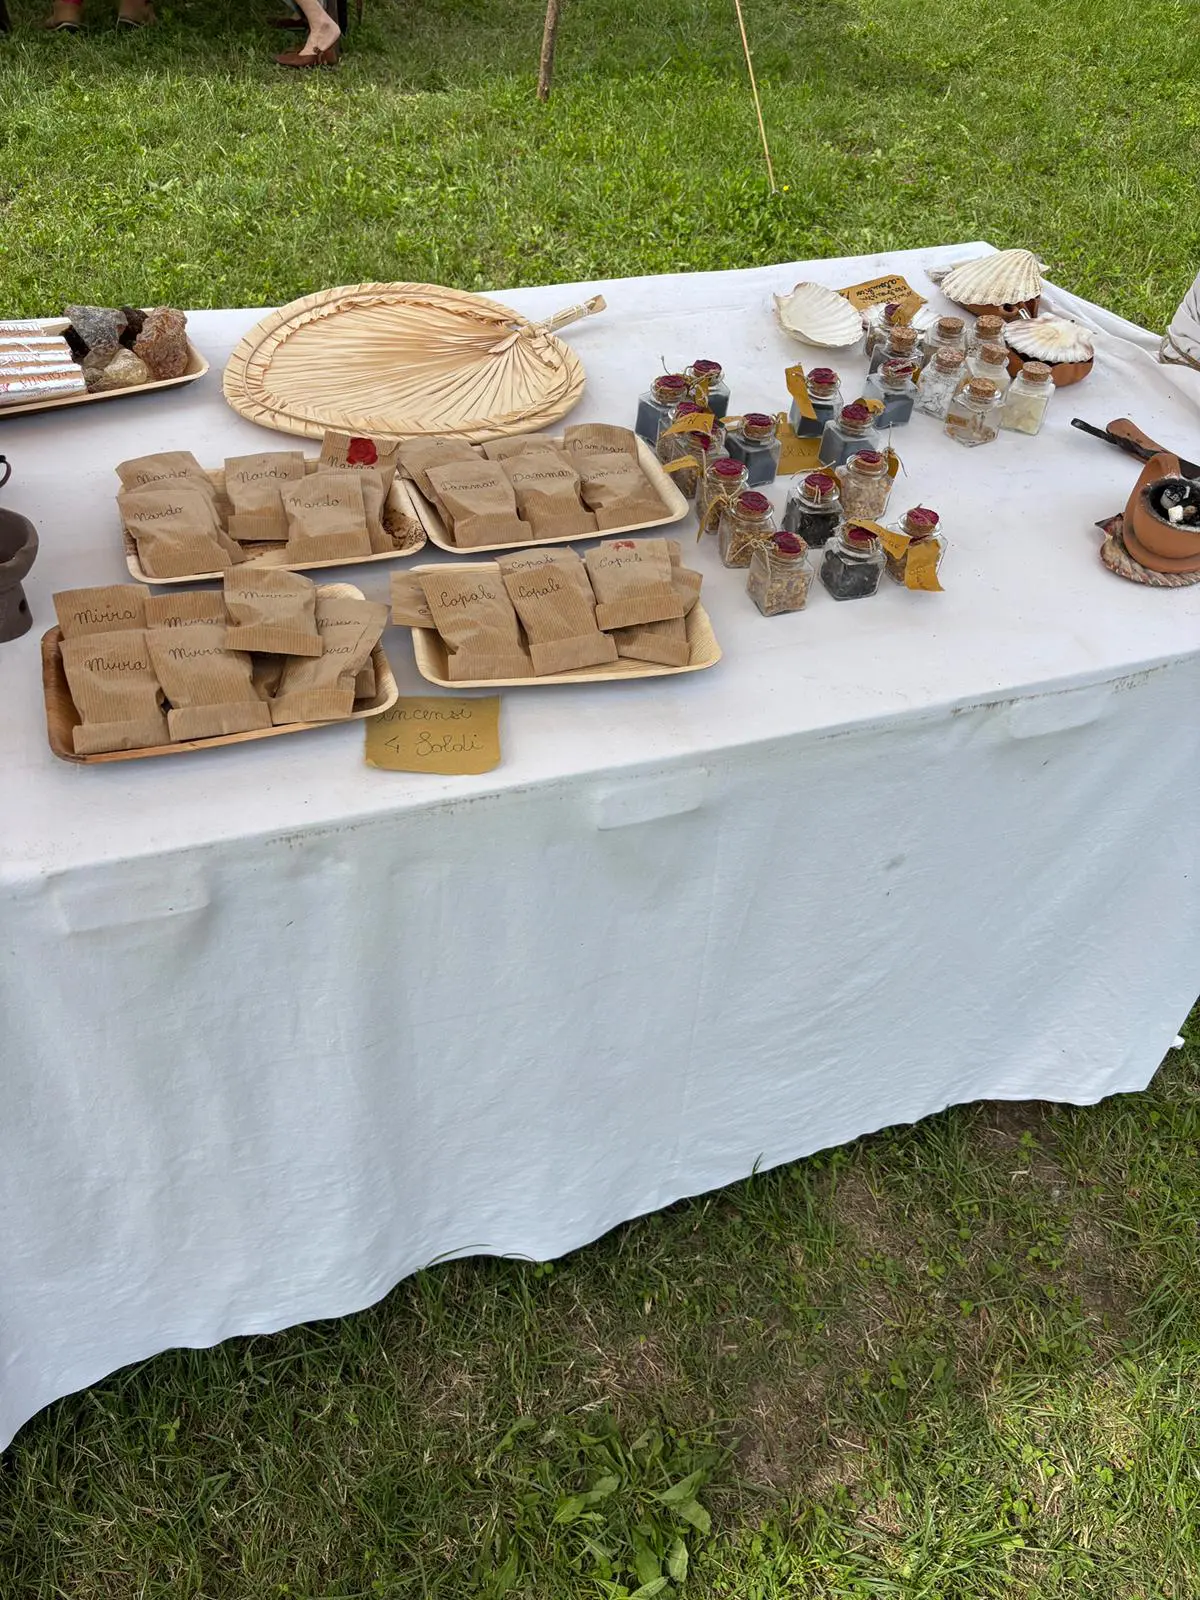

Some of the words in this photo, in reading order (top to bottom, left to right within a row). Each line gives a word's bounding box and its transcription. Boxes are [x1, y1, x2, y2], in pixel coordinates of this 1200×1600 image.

[237, 466, 290, 483] Nardo
[512, 470, 572, 483] Dammar
[290, 494, 342, 509] Nardo
[133, 504, 184, 522] Nardo
[439, 584, 496, 609] Copale
[518, 577, 562, 599] Copale
[74, 604, 138, 625] Mirra
[169, 646, 226, 661] Mirra
[84, 656, 148, 672] Mirra
[384, 735, 400, 754] 4
[415, 731, 485, 757] Soldi
